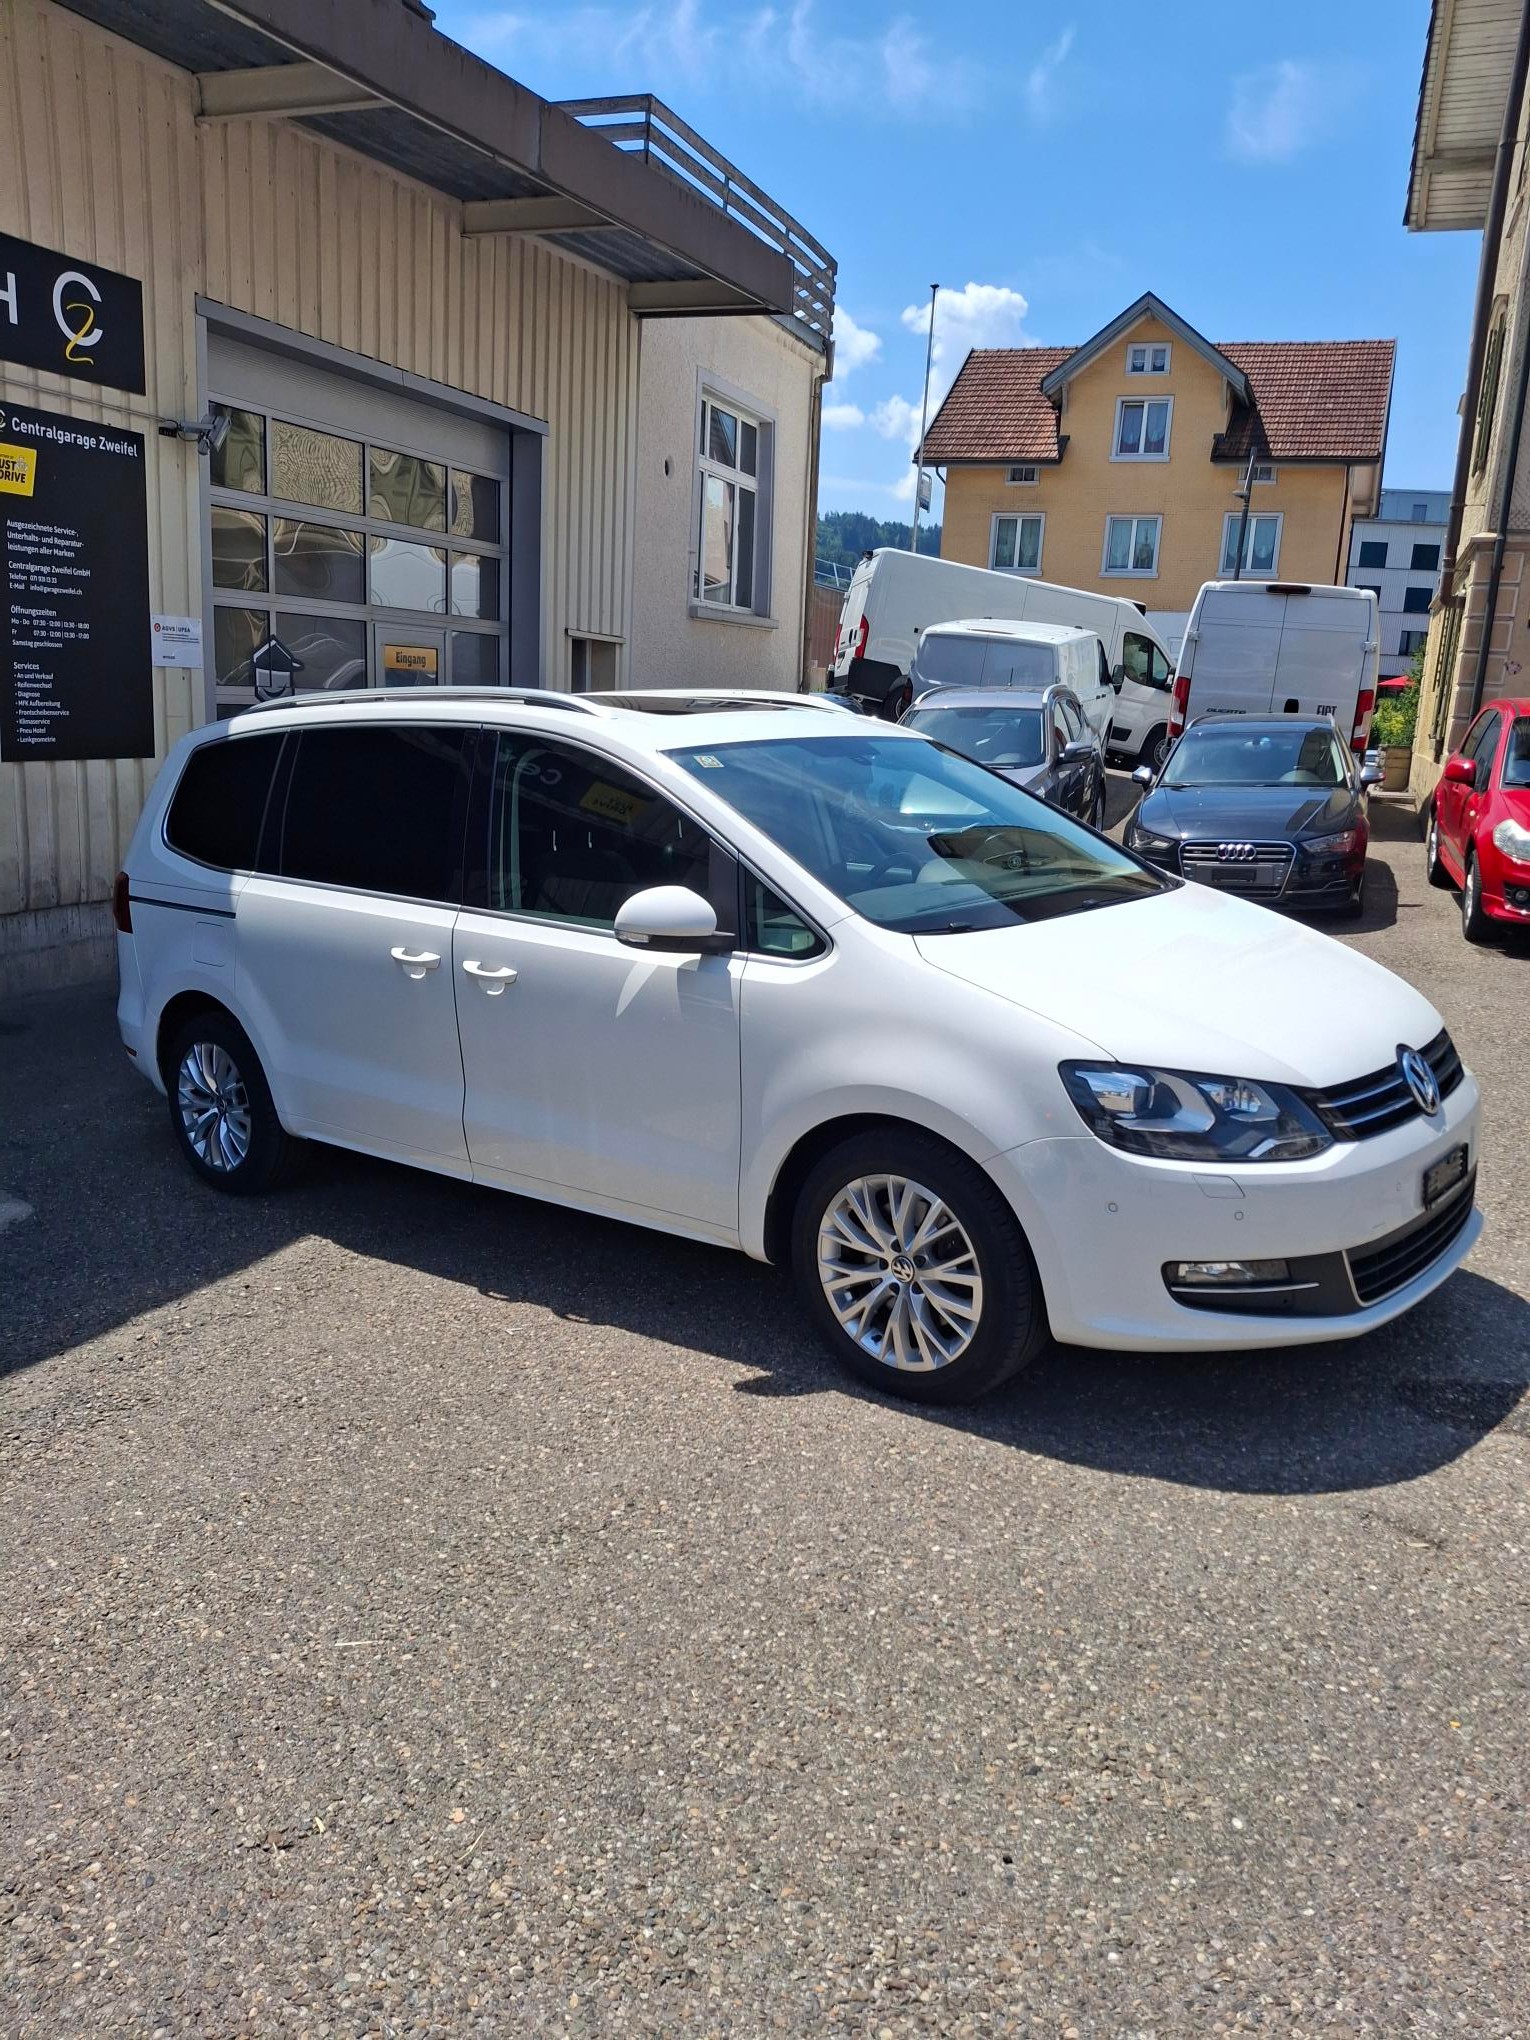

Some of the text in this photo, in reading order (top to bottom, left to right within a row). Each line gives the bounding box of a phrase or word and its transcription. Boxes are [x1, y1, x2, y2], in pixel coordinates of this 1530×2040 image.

[11, 417, 97, 450] Centralgarage
[98, 436, 138, 458] Zweifel
[6, 519, 53, 532] Ausgezeichnete
[7, 531, 85, 549] Unterhalts- und Reparatur-
[8, 541, 75, 558] leistungen aller Marken
[8, 560, 91, 578] Centralgarage Zweifel GmbH
[8, 572, 28, 581] Telefon
[9, 582, 25, 590] E-Mail
[10, 604, 57, 618] Öffnungszeiten
[12, 639, 63, 649] Samstag geschlossen
[13, 661, 40, 670] Services
[395, 651, 427, 668] Eingang
[34, 672, 54, 680] Verkauf
[17, 681, 53, 689] Reifenwechsel
[17, 690, 41, 699] Diagnose
[1316, 704, 1338, 717] FIAT
